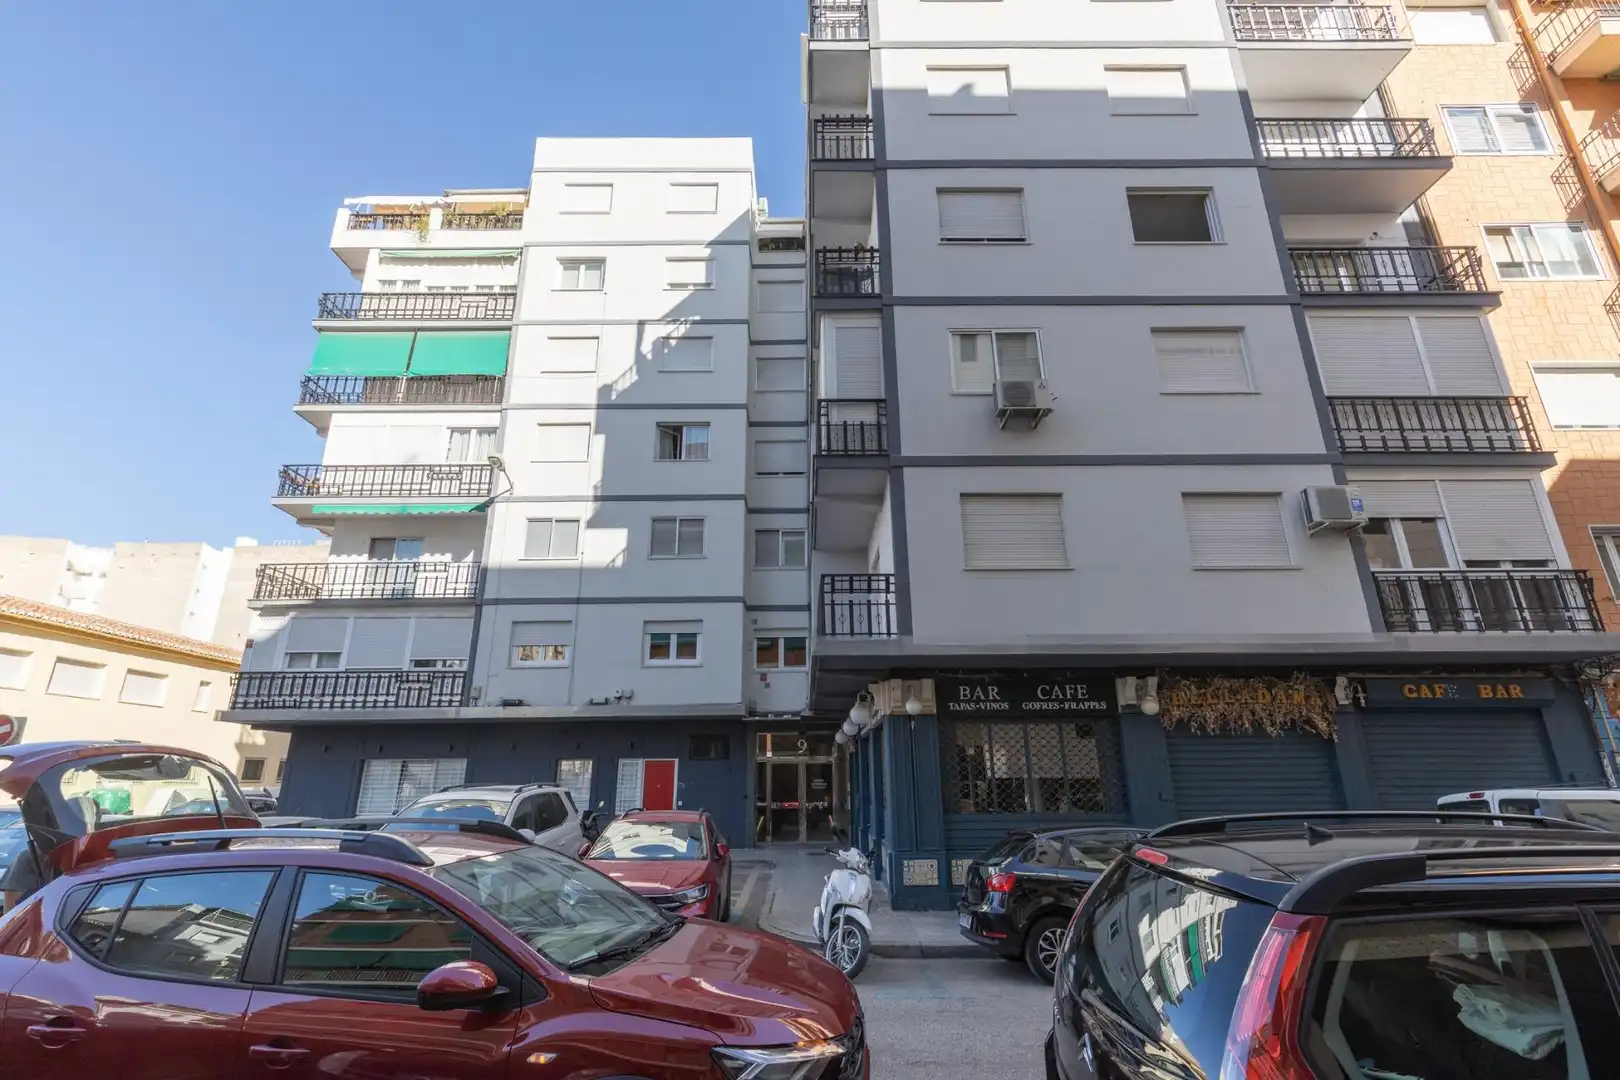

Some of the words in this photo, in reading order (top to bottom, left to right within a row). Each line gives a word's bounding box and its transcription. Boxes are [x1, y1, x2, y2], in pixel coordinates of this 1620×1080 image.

[959, 685, 1001, 700] BAR
[1037, 685, 1089, 699] CAFE
[1476, 683, 1525, 699] BAR
[948, 701, 1009, 711] TAPAS-VINOS
[798, 739, 807, 753] 9
